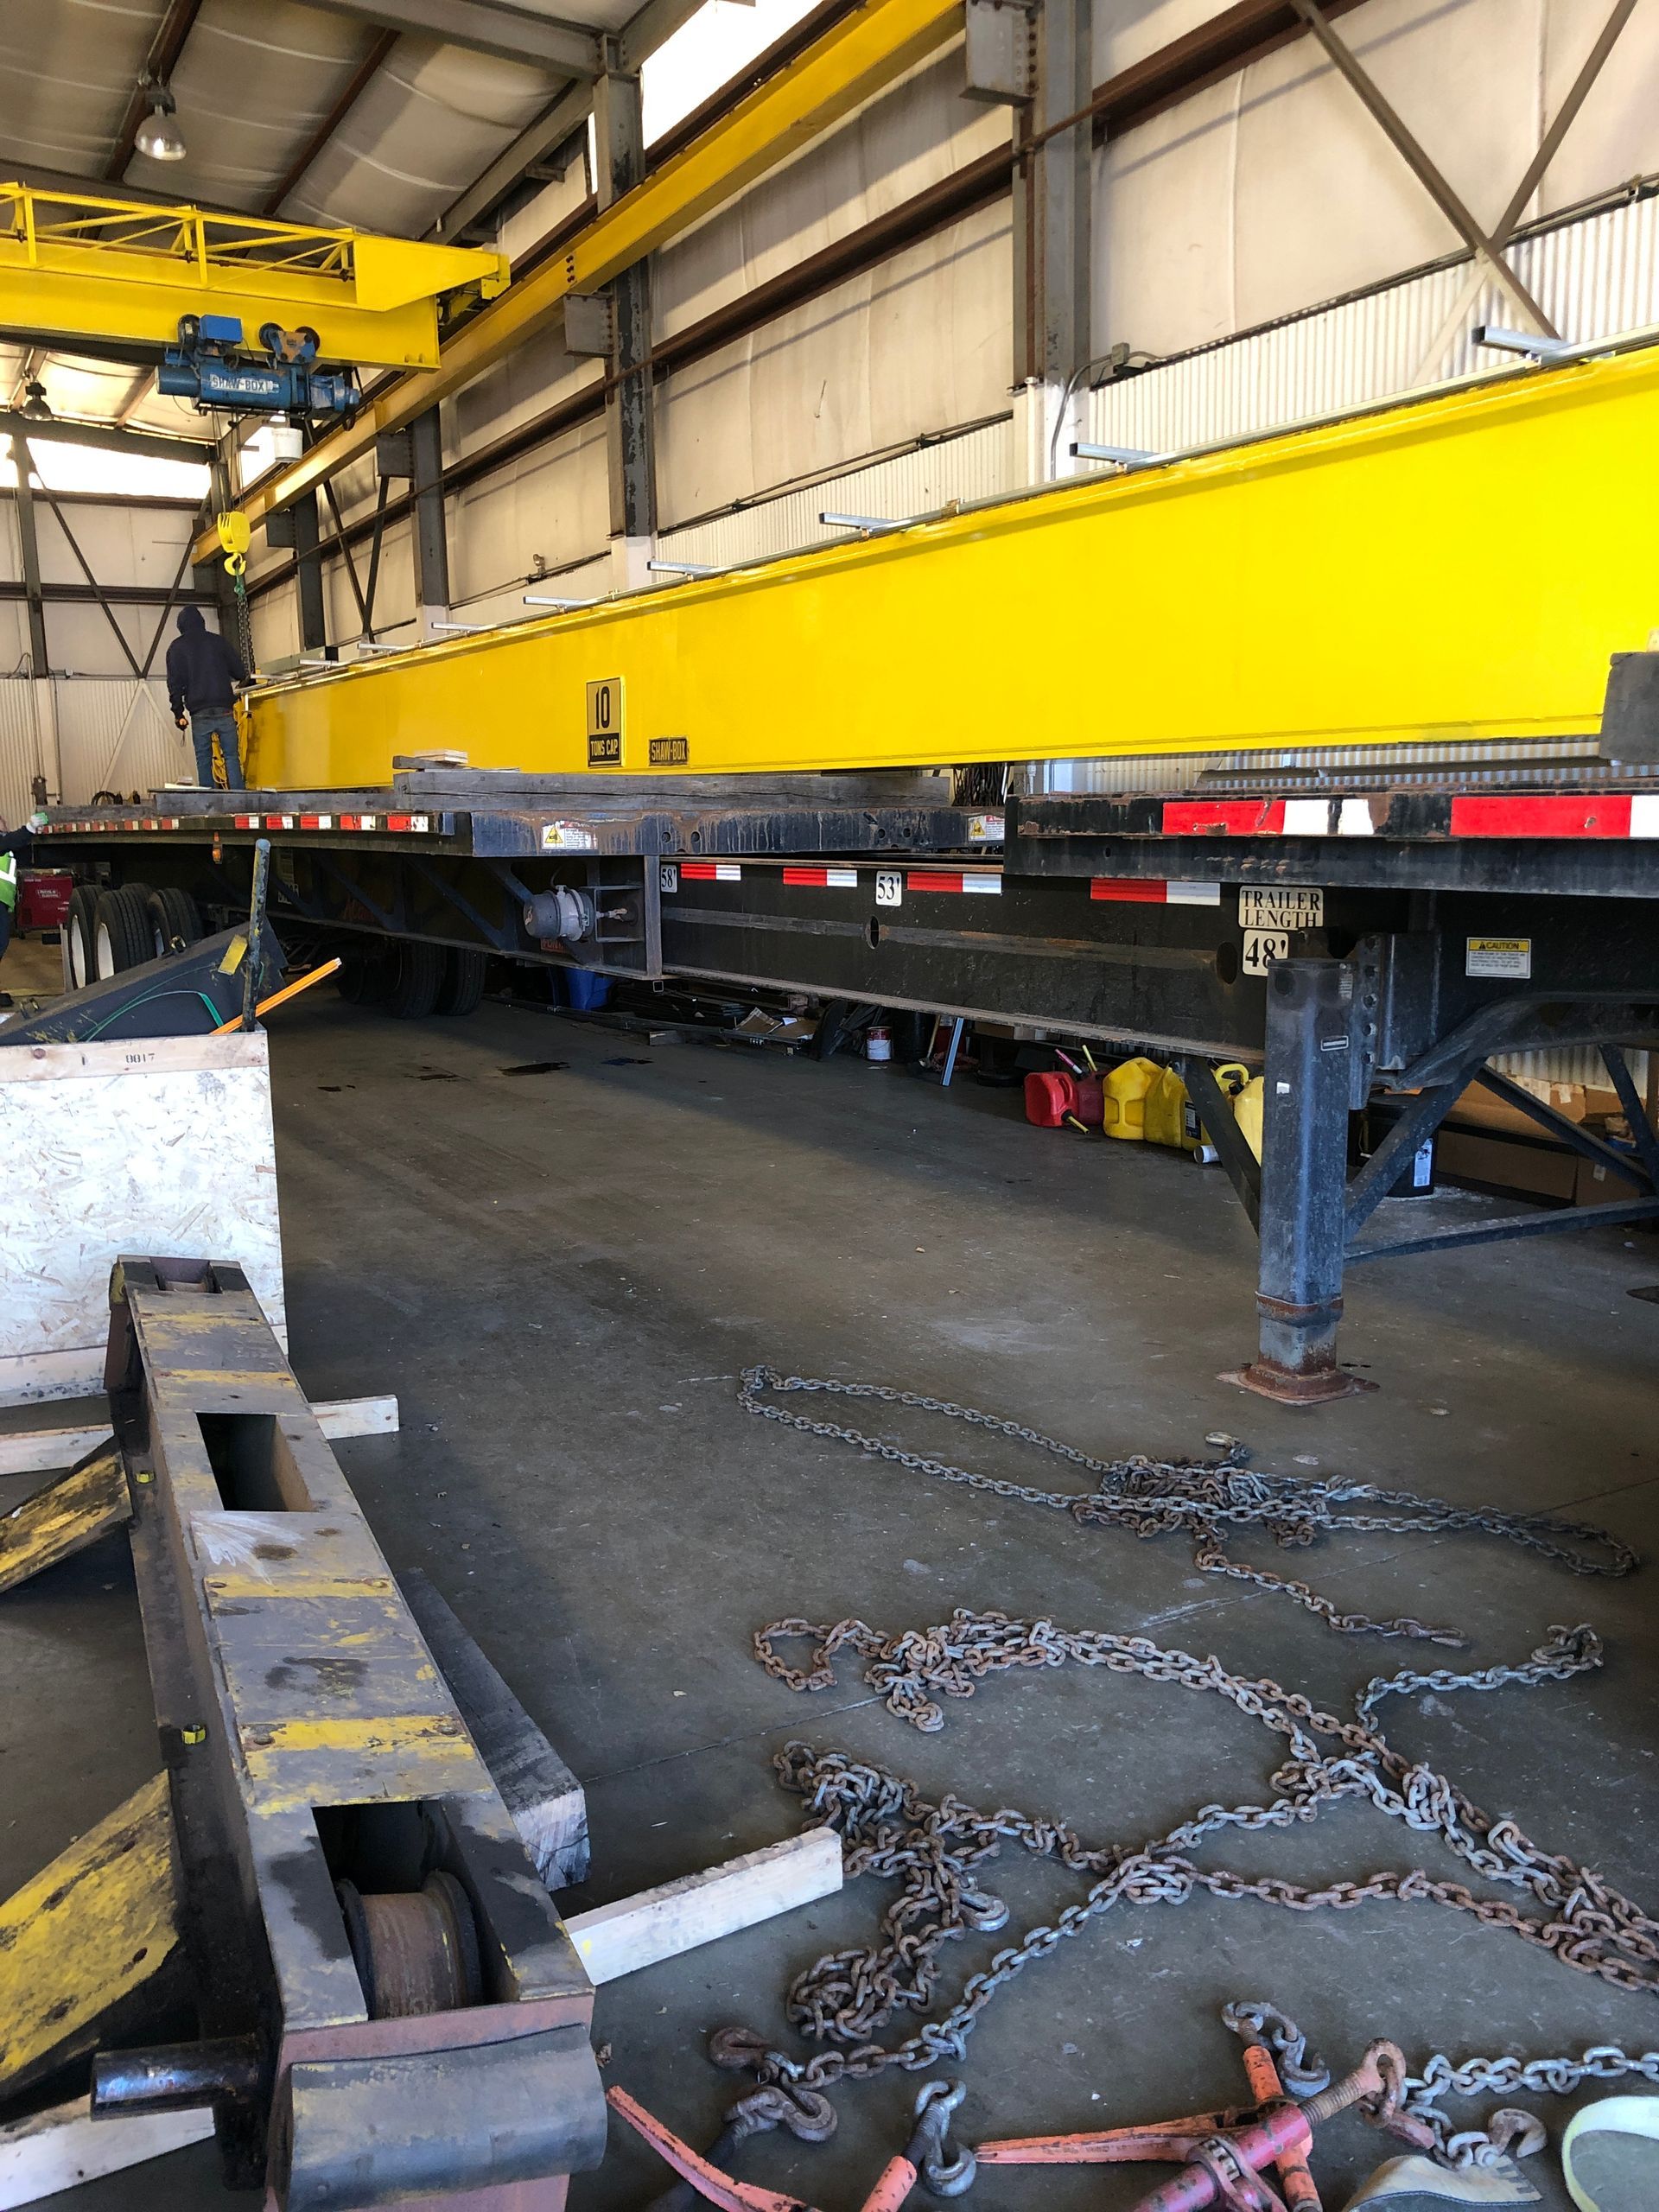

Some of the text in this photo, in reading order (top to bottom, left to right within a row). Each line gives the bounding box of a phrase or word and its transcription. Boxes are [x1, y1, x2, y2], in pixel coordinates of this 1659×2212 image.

[213, 376, 265, 392] SHAW-BOX
[595, 686, 610, 730] 10
[590, 741, 605, 757] TONS
[651, 741, 686, 761] SHAW-BOX
[877, 875, 900, 900] 53'
[1242, 890, 1321, 912] TRAILER
[1243, 909, 1318, 929] LENGTH
